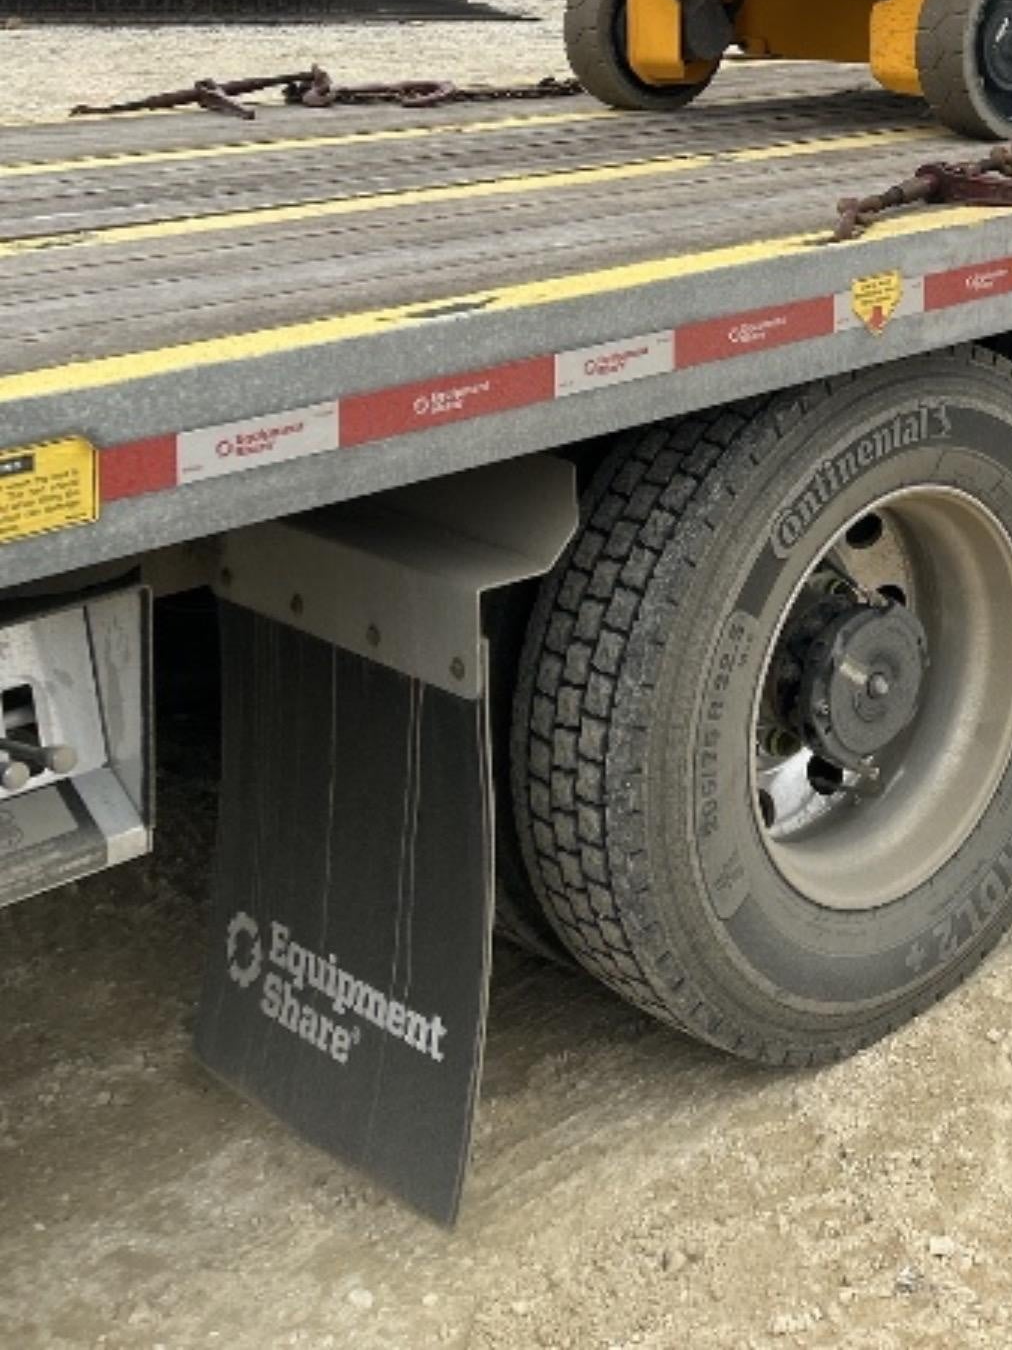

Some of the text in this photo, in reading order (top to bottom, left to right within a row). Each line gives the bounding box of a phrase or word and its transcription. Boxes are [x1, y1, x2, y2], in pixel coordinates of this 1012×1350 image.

[771, 405, 932, 558] Continental
[260, 971, 351, 1064] Share
[269, 920, 447, 1062] Equipment
